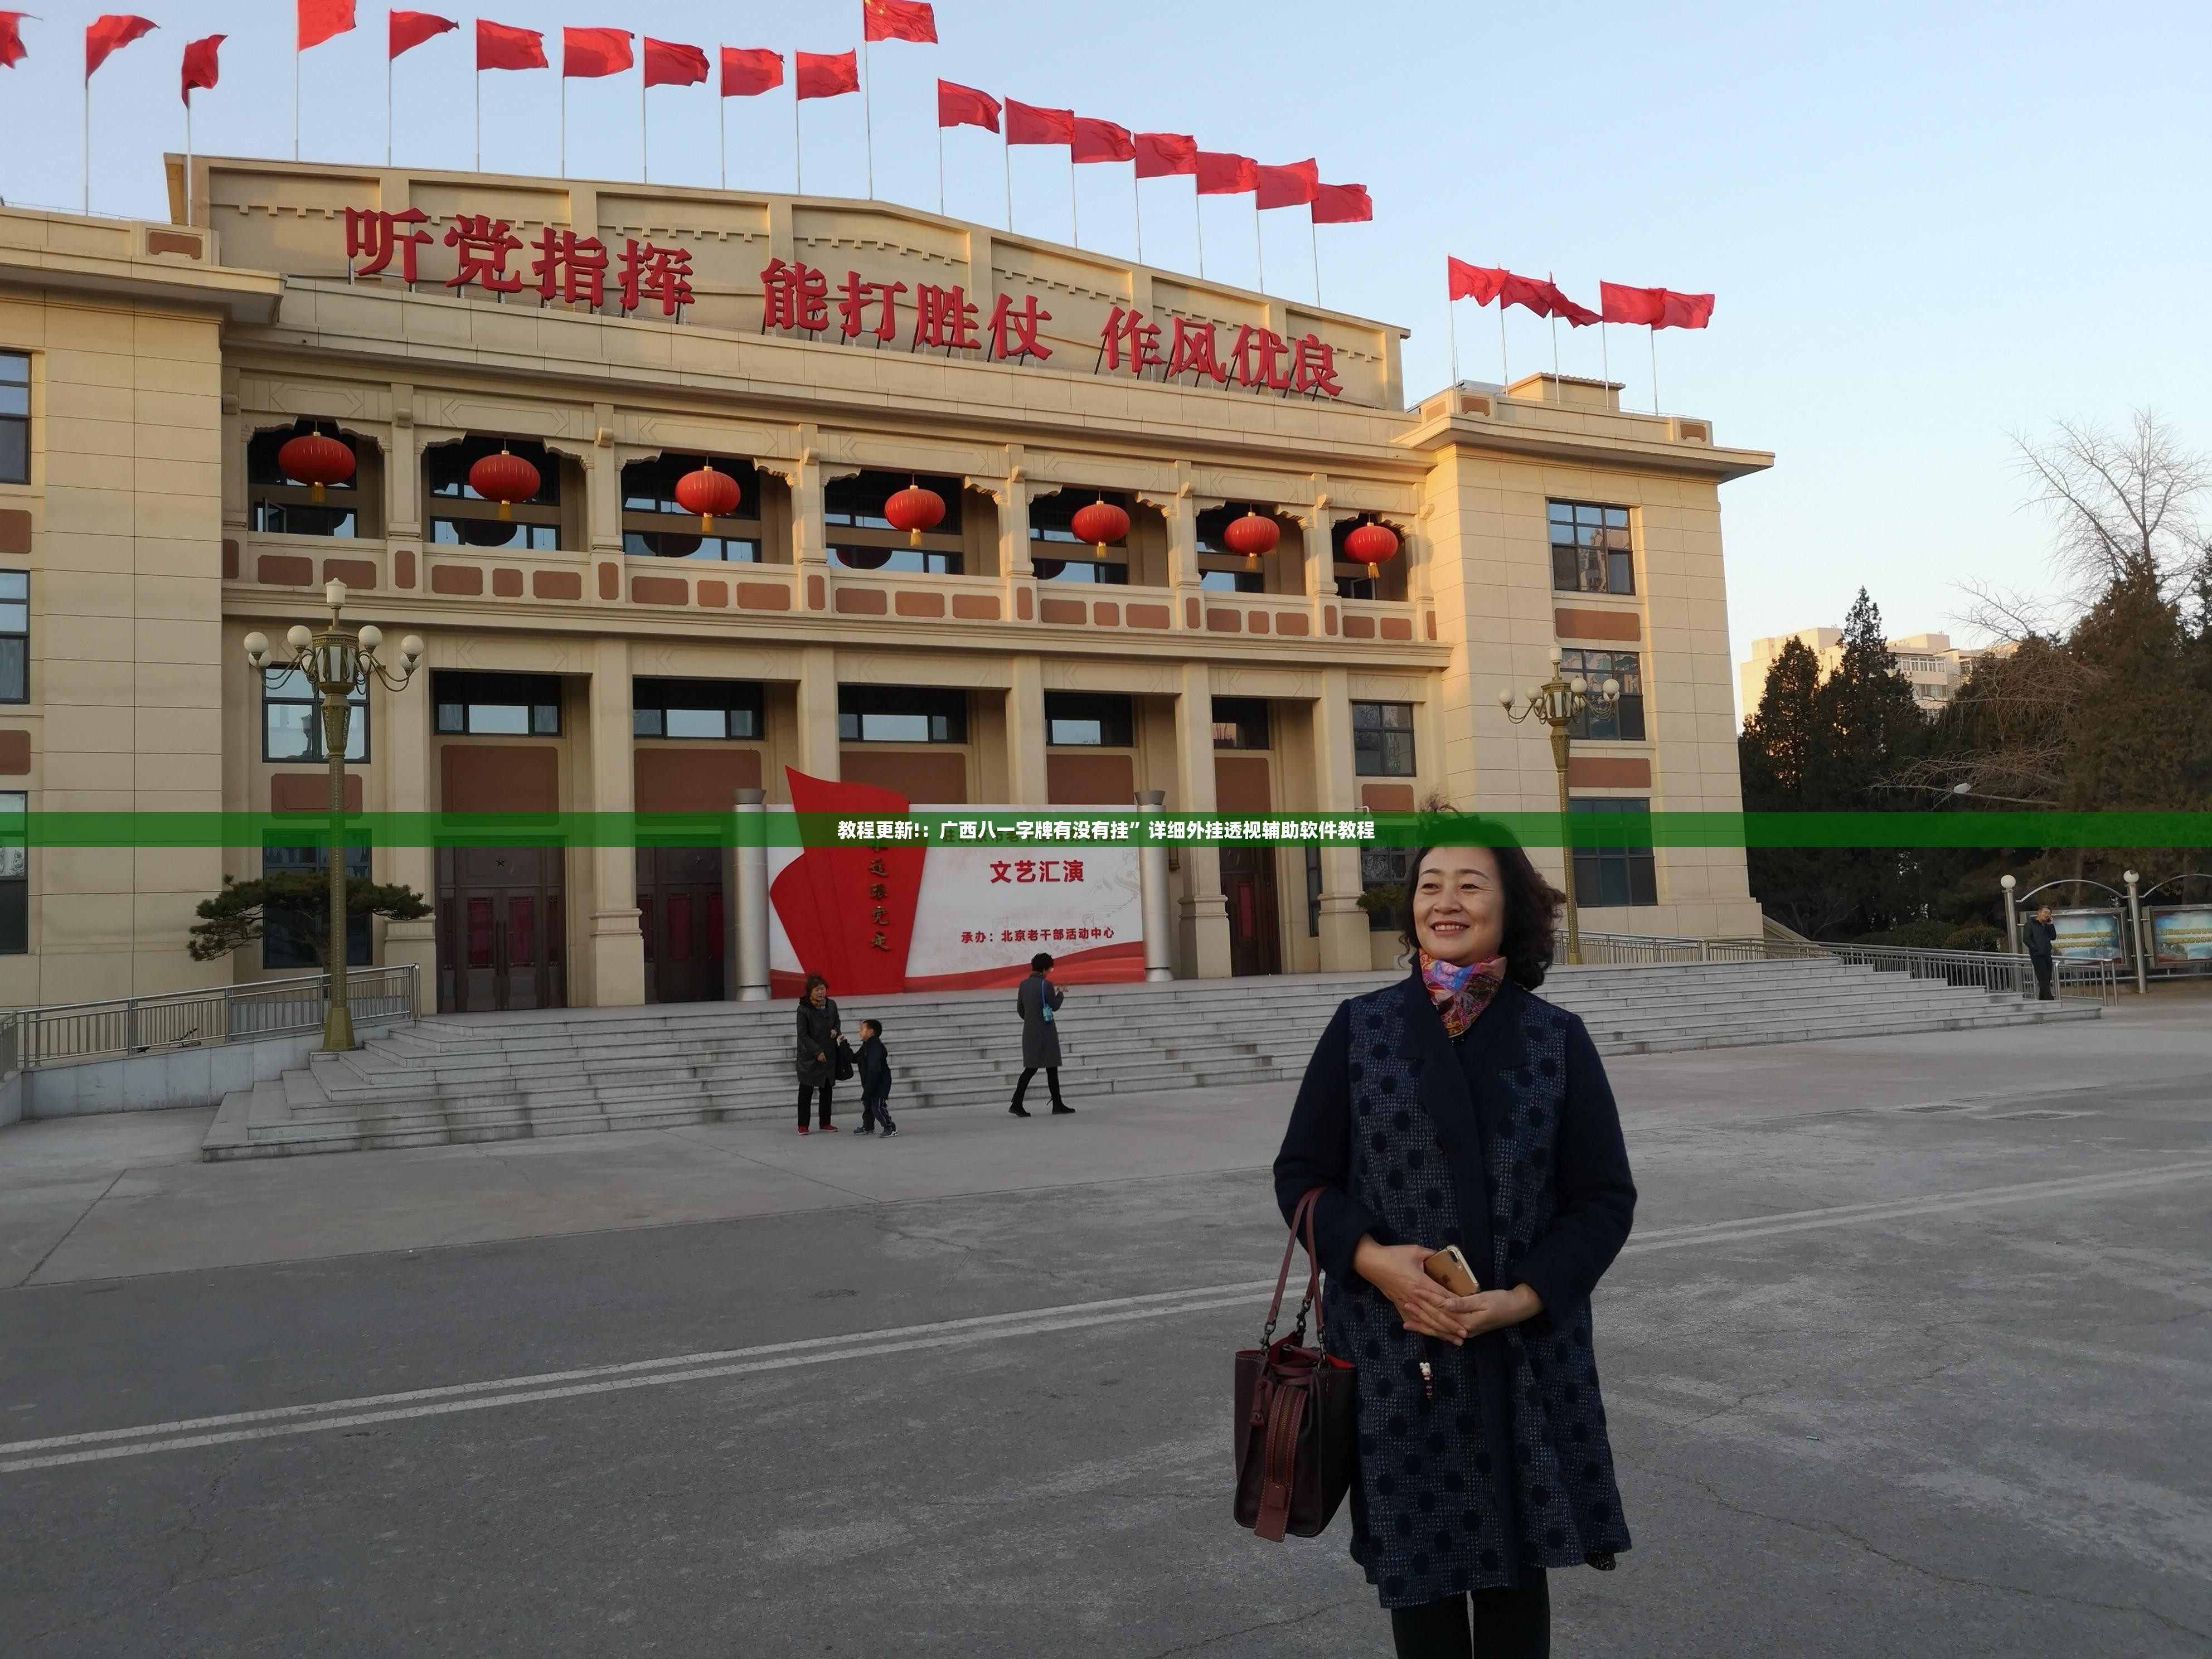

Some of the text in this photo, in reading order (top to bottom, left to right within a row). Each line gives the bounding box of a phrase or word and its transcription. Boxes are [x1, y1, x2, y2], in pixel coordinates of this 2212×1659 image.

[344, 206, 1343, 397] 听党指挥 能打胜仗 作风优良
[989, 860, 1084, 884] 文艺汇演
[961, 926, 1114, 944] 承办：北京老干部活动中心
